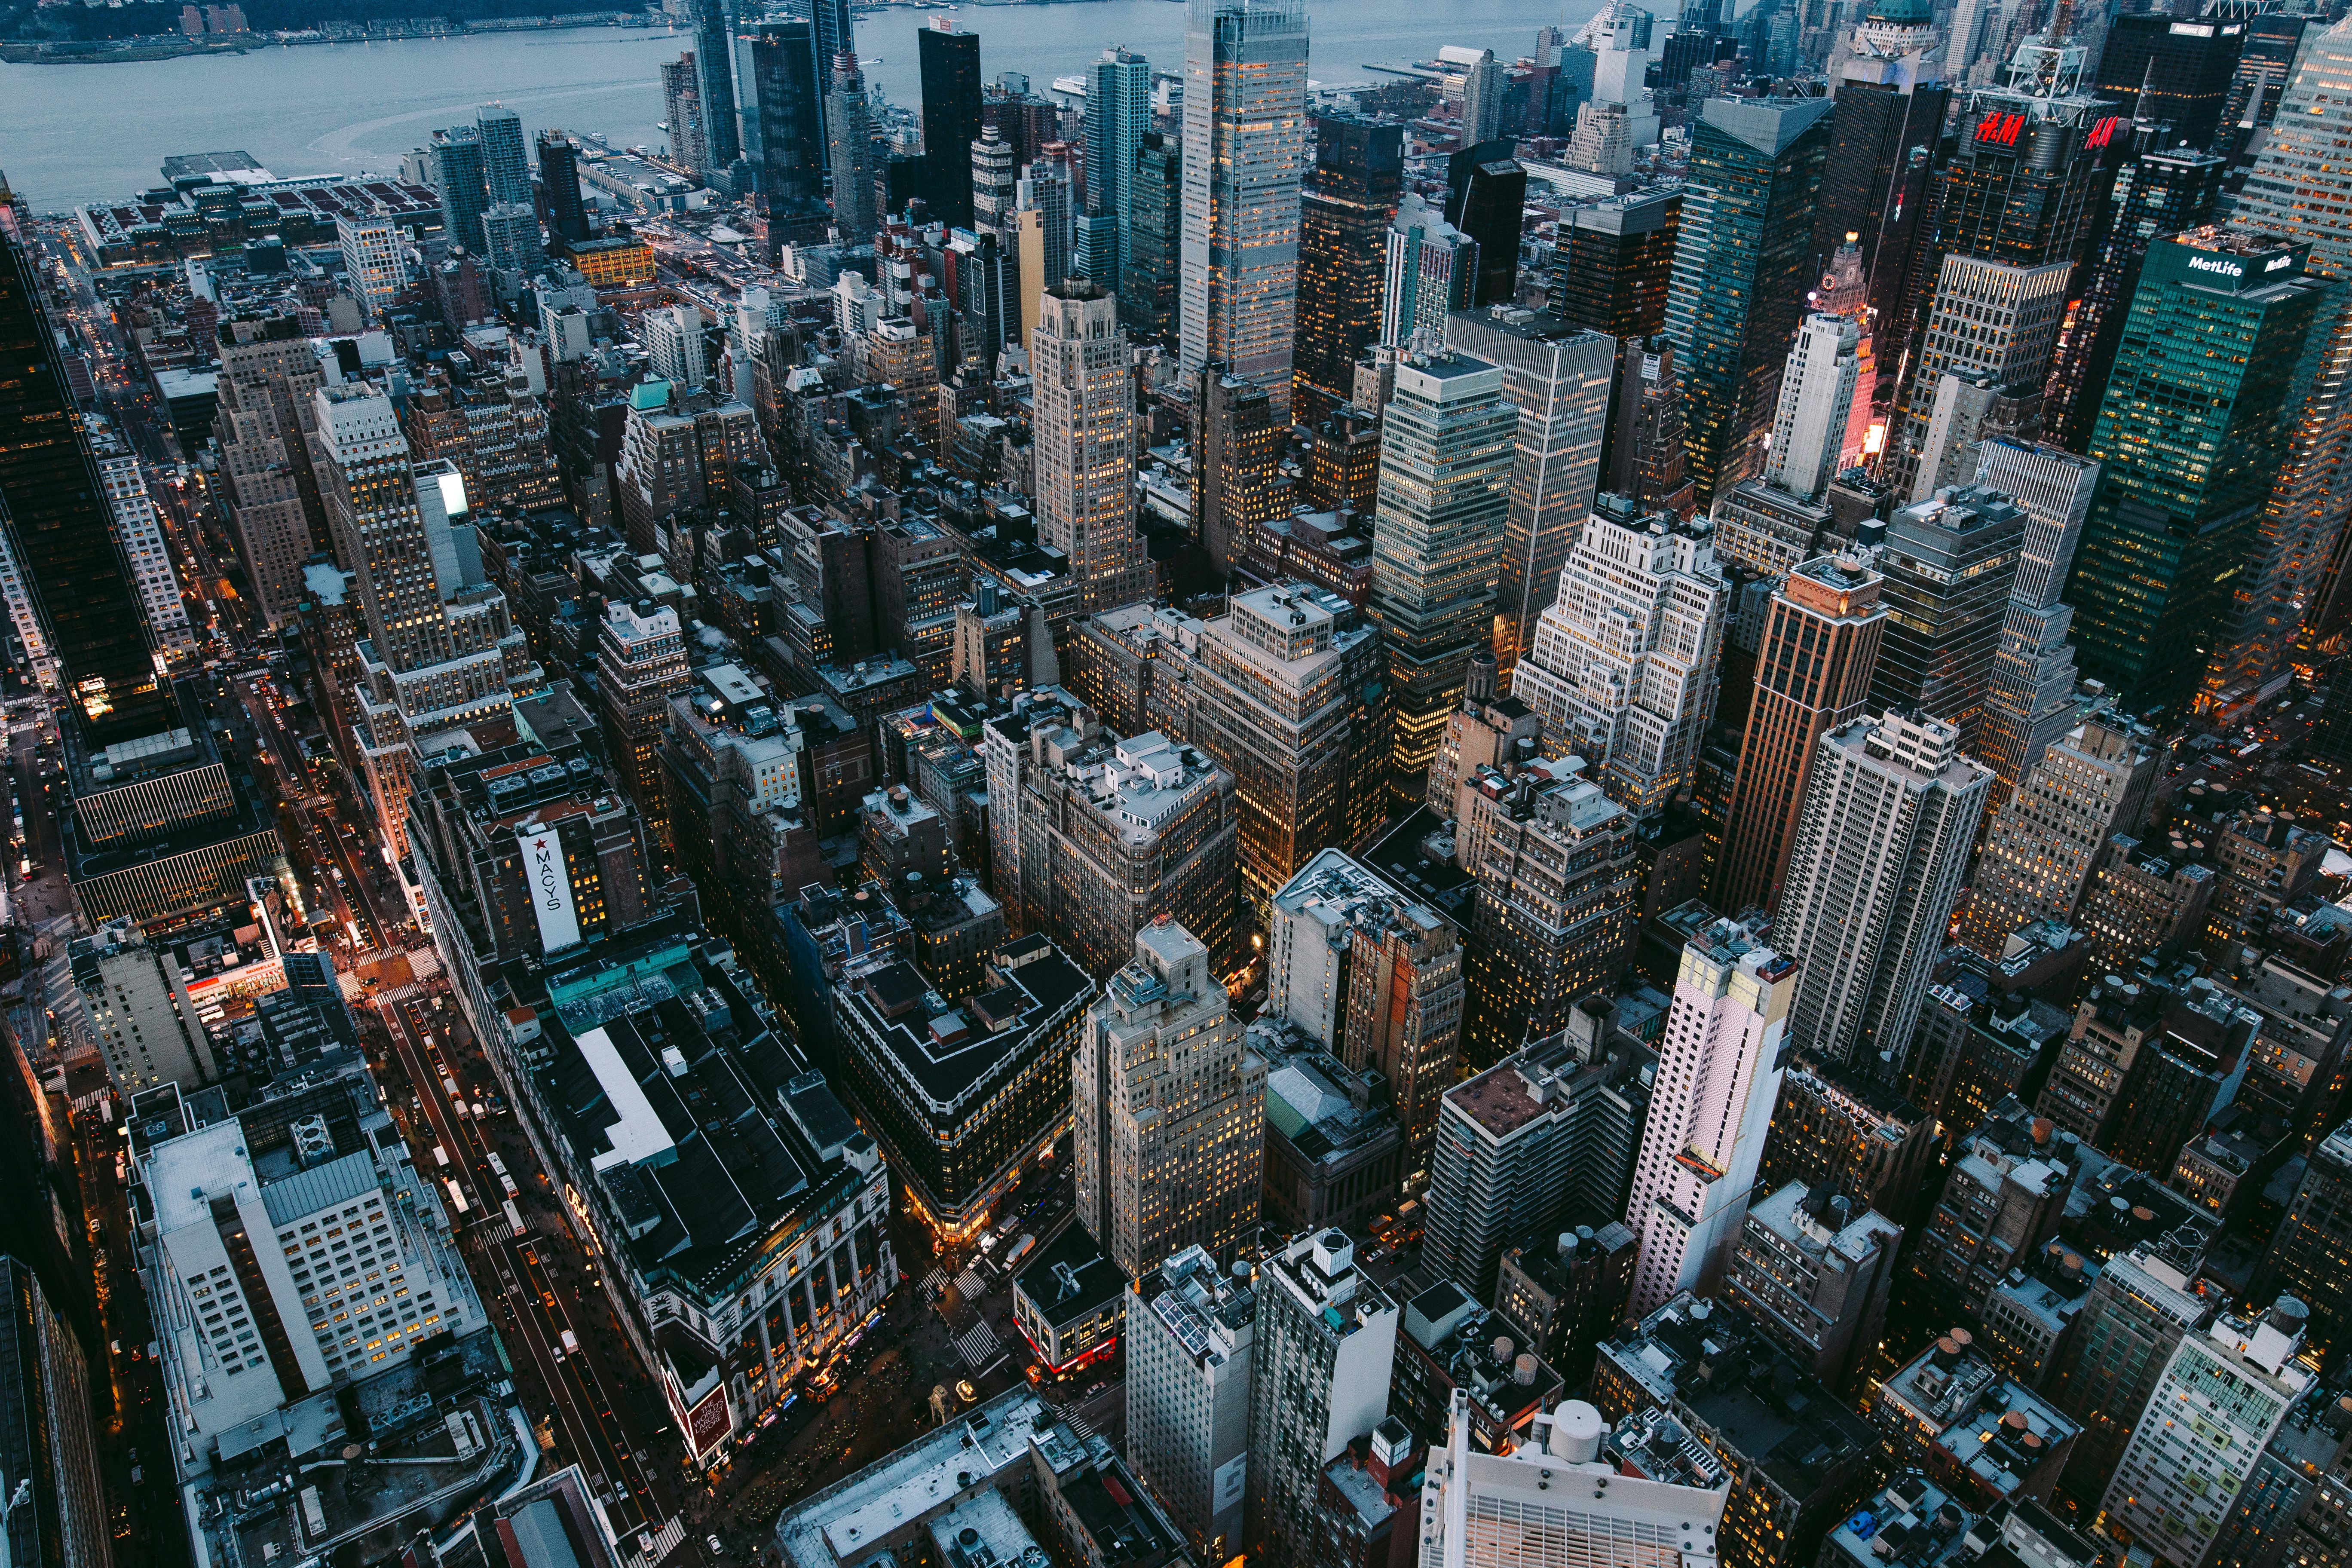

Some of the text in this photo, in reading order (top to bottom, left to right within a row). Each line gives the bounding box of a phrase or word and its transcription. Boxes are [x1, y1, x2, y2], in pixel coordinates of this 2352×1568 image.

[2174, 25, 2198, 34] Allianz
[1975, 111, 2025, 147] H&M
[2085, 116, 2118, 150] H&M
[2188, 257, 2242, 276] MetLife
[2264, 255, 2291, 273] MetLife
[463, 1184, 472, 1194] BUS
[469, 1197, 480, 1208] ONLY
[541, 1253, 552, 1263] ONLY
[502, 1269, 511, 1279] BUS
[548, 1268, 558, 1278] BUS
[508, 1283, 519, 1295] ONLY
[693, 1398, 723, 1427] WORLD'S
[701, 1399, 714, 1414] THE
[695, 1404, 723, 1434] LARGEST
[701, 1414, 722, 1436] STORE
[636, 1448, 649, 1462] ONLY
[591, 1472, 604, 1487] BUS
[646, 1468, 657, 1481] BUS
[601, 1491, 614, 1507] ONLY
